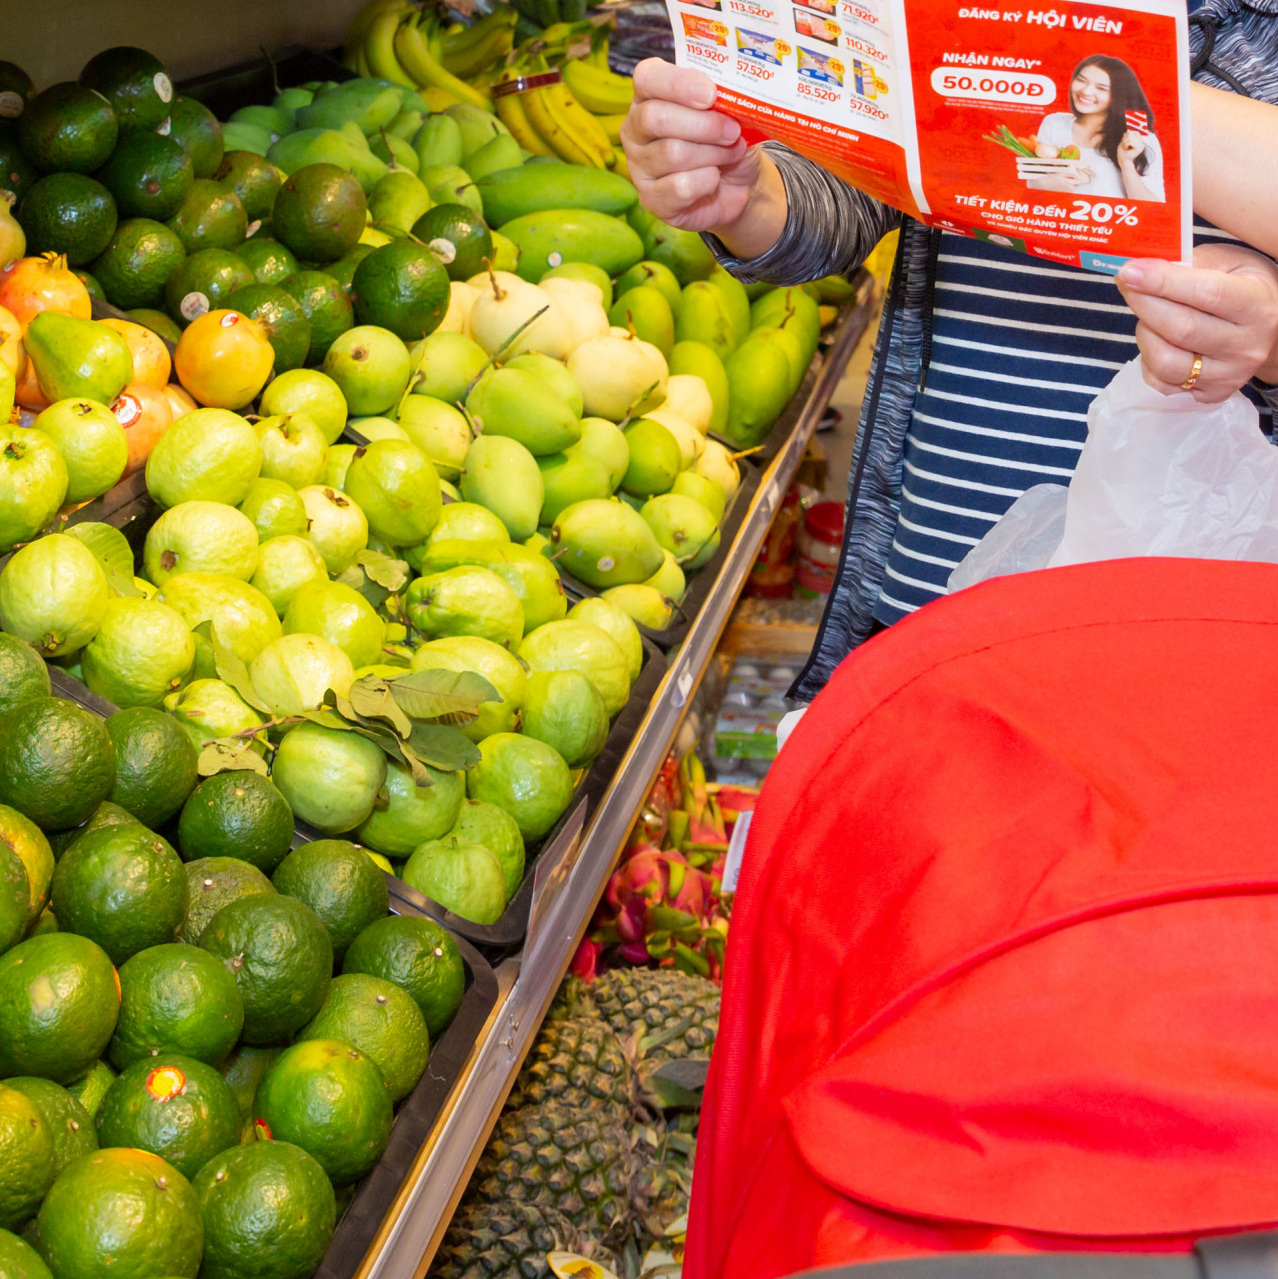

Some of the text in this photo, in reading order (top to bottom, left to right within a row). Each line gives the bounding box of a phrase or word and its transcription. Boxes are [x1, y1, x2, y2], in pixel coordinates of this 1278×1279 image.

[958, 7, 1000, 21] ĐĂNG
[1027, 9, 1065, 29] HỘI
[1072, 15, 1123, 35] VIÊN
[942, 52, 989, 66] NHẬN
[943, 75, 1044, 97] 50.000Đ
[954, 194, 1139, 226] TIẾT KIỆM ĐẾN 20%
[980, 211, 1004, 220] CHO
[1026, 218, 1057, 228] HÀNG
[1059, 222, 1089, 232] THIẾT
[1091, 225, 1113, 235] YẾU
